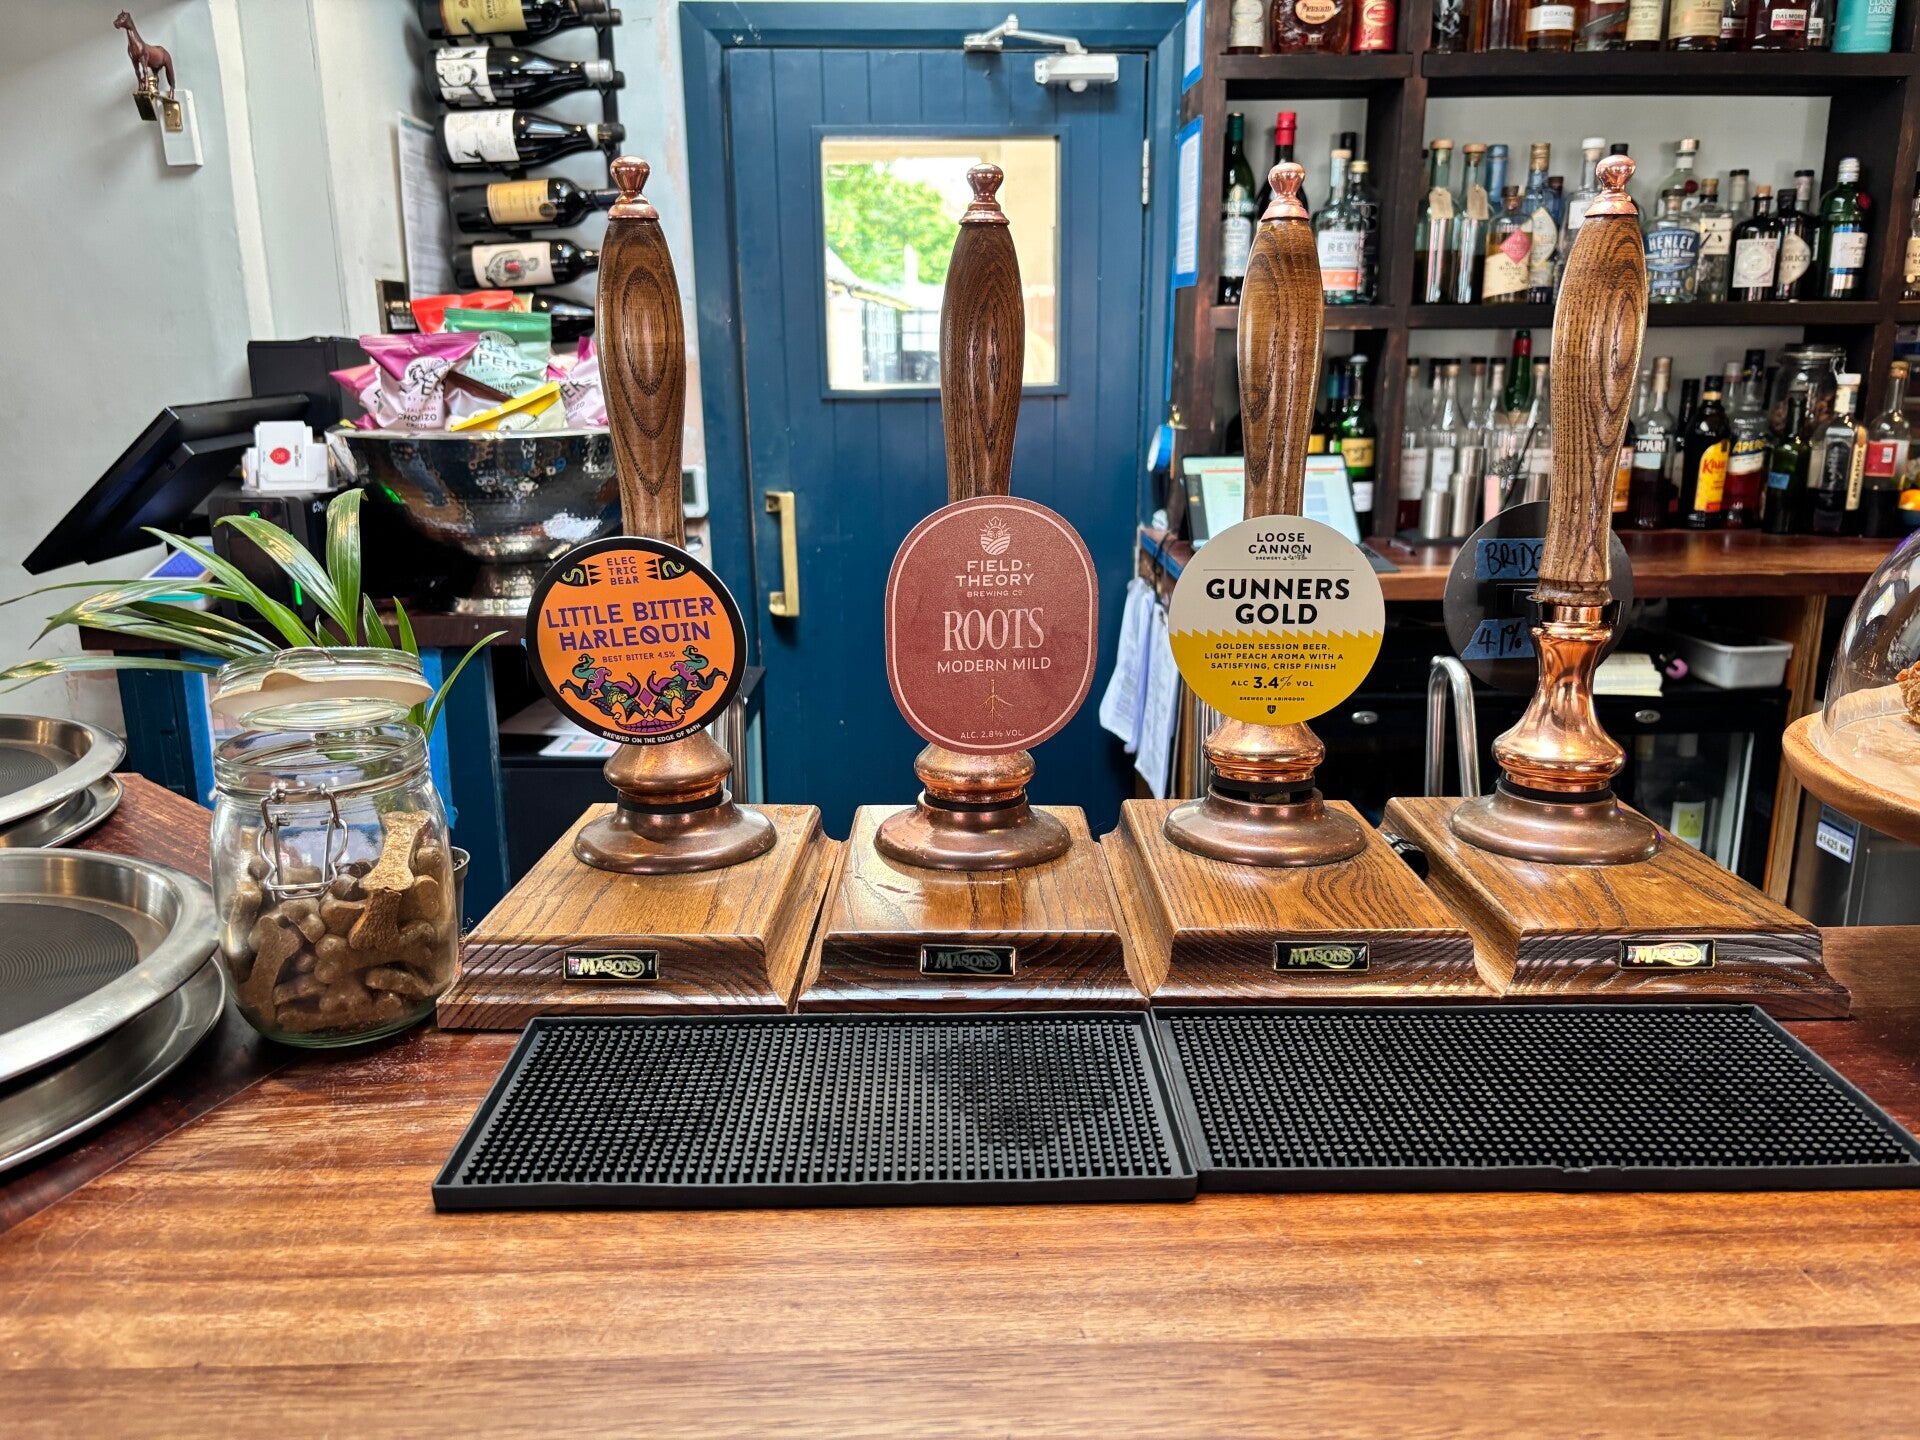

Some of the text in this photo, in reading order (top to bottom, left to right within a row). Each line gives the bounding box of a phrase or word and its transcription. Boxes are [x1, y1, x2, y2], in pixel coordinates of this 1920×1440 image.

[1648, 234, 1694, 251] HENLEY
[1257, 533, 1304, 542] LOOSE
[1248, 544, 1312, 554] CANNON
[606, 557, 635, 566] ELEC
[967, 560, 1023, 572] FIELD
[608, 566, 638, 575] TRIC
[610, 576, 639, 585] BEAR
[955, 573, 1034, 587] THEORY
[1206, 578, 1350, 600] GUNNERS
[546, 596, 716, 628] LITTLE BITTER
[1236, 604, 1317, 624] GOLD
[559, 621, 711, 651] HARLEQUIN
[942, 607, 1045, 652] ROOTS
[602, 651, 675, 663] BEST BITTER 4.5%
[937, 657, 1051, 673] MODERN MILD
[1253, 675, 1294, 691] 3.4%
[602, 731, 630, 742] BREWED
[686, 723, 702, 734] BATH
[934, 952, 997, 969] MASONS
[1288, 948, 1351, 965] MASONS
[577, 958, 641, 975] MASONS
